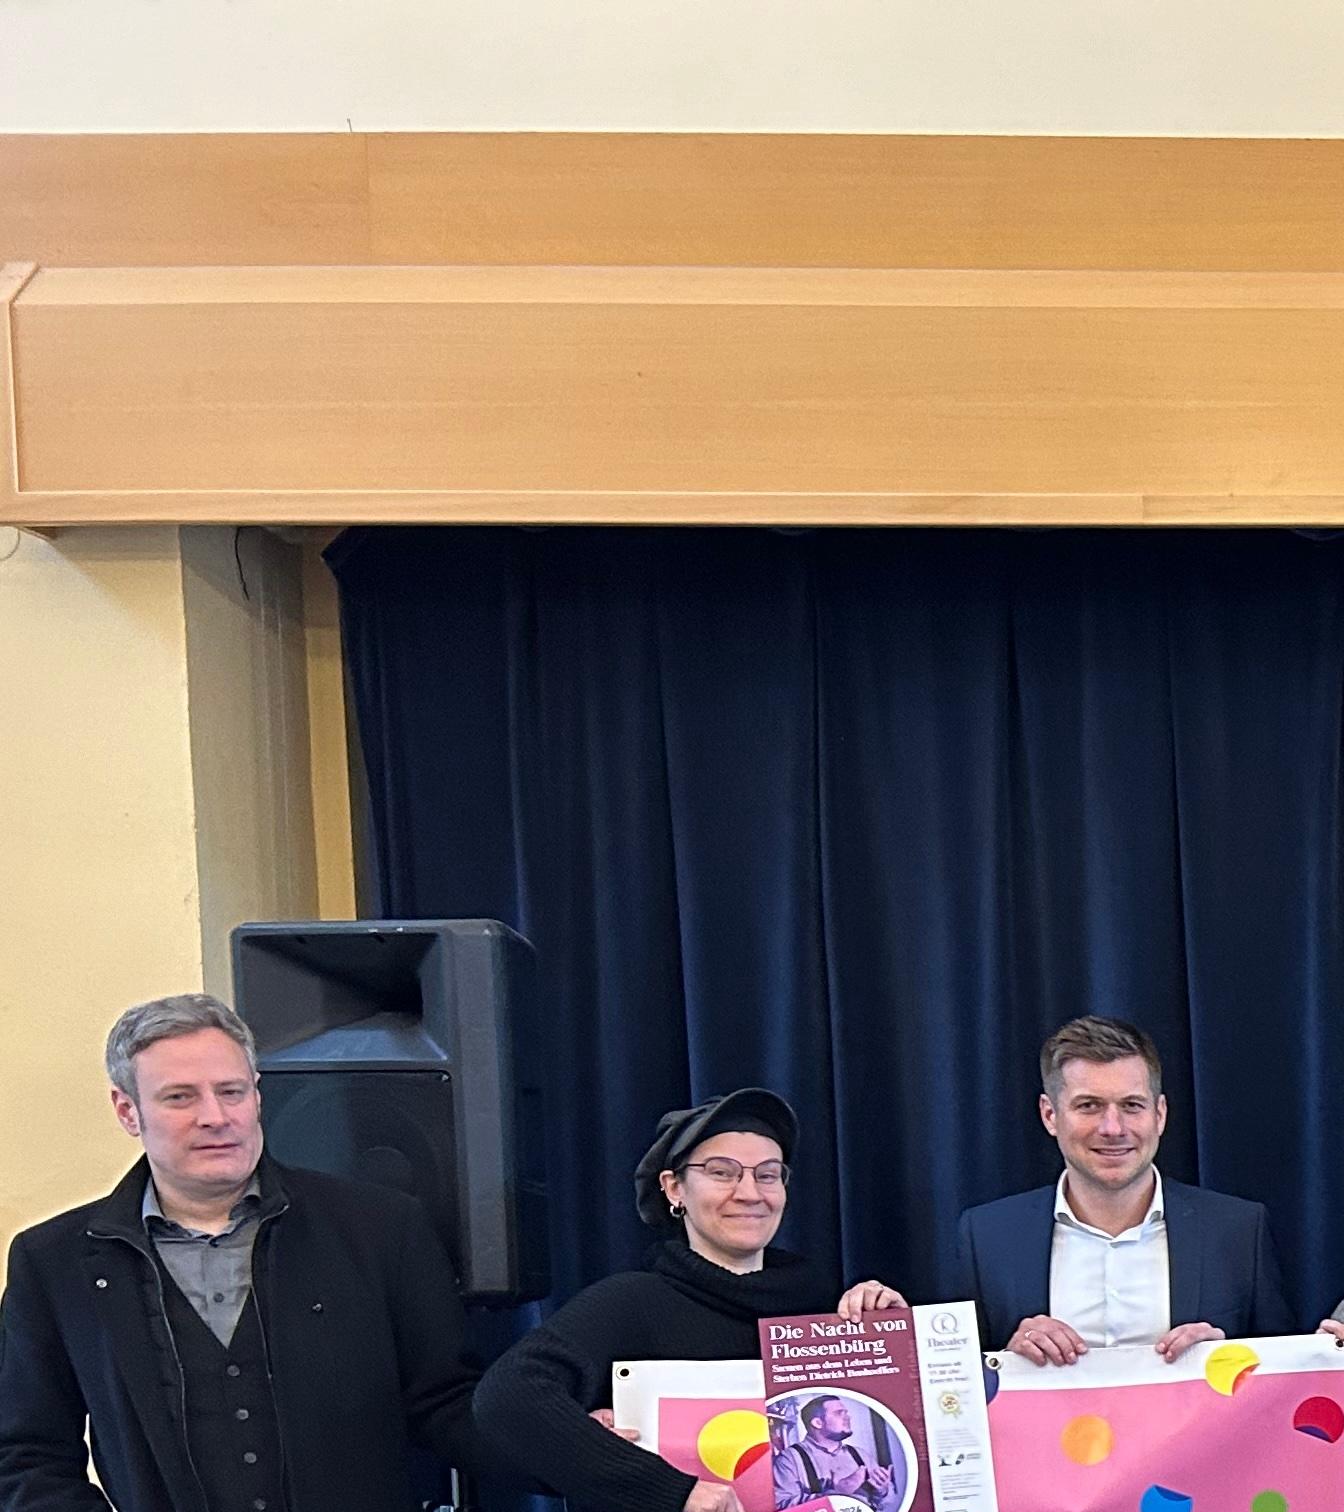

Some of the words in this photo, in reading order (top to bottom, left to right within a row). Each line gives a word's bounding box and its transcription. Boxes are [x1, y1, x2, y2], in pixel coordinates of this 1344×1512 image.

[769, 1325, 803, 1341] Die
[810, 1320, 866, 1338] Nacht
[873, 1319, 907, 1332] von
[771, 1339, 886, 1359] Flossenbürg
